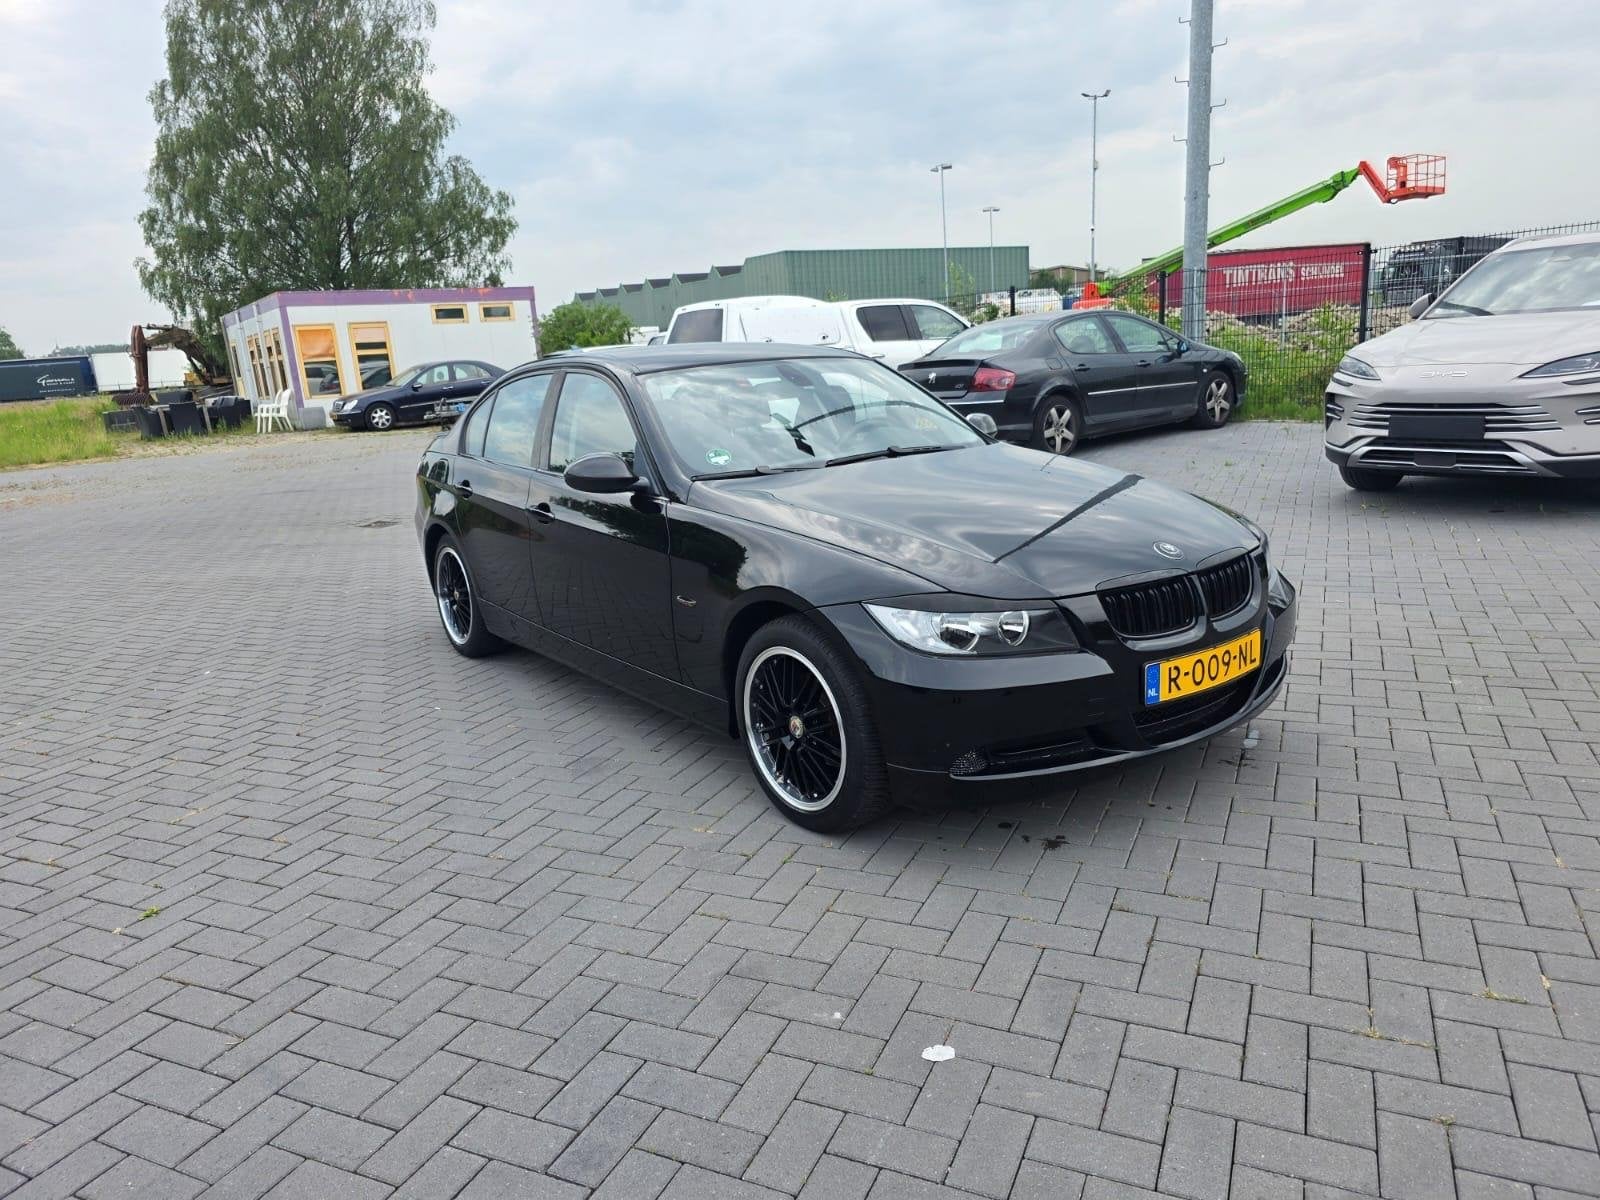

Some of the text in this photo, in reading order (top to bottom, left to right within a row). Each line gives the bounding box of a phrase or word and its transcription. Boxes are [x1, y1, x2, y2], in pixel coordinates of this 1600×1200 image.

[1223, 261, 1295, 288] TIMTRANS
[1168, 640, 1257, 693] R-009-NL
[1147, 687, 1158, 698] NL
